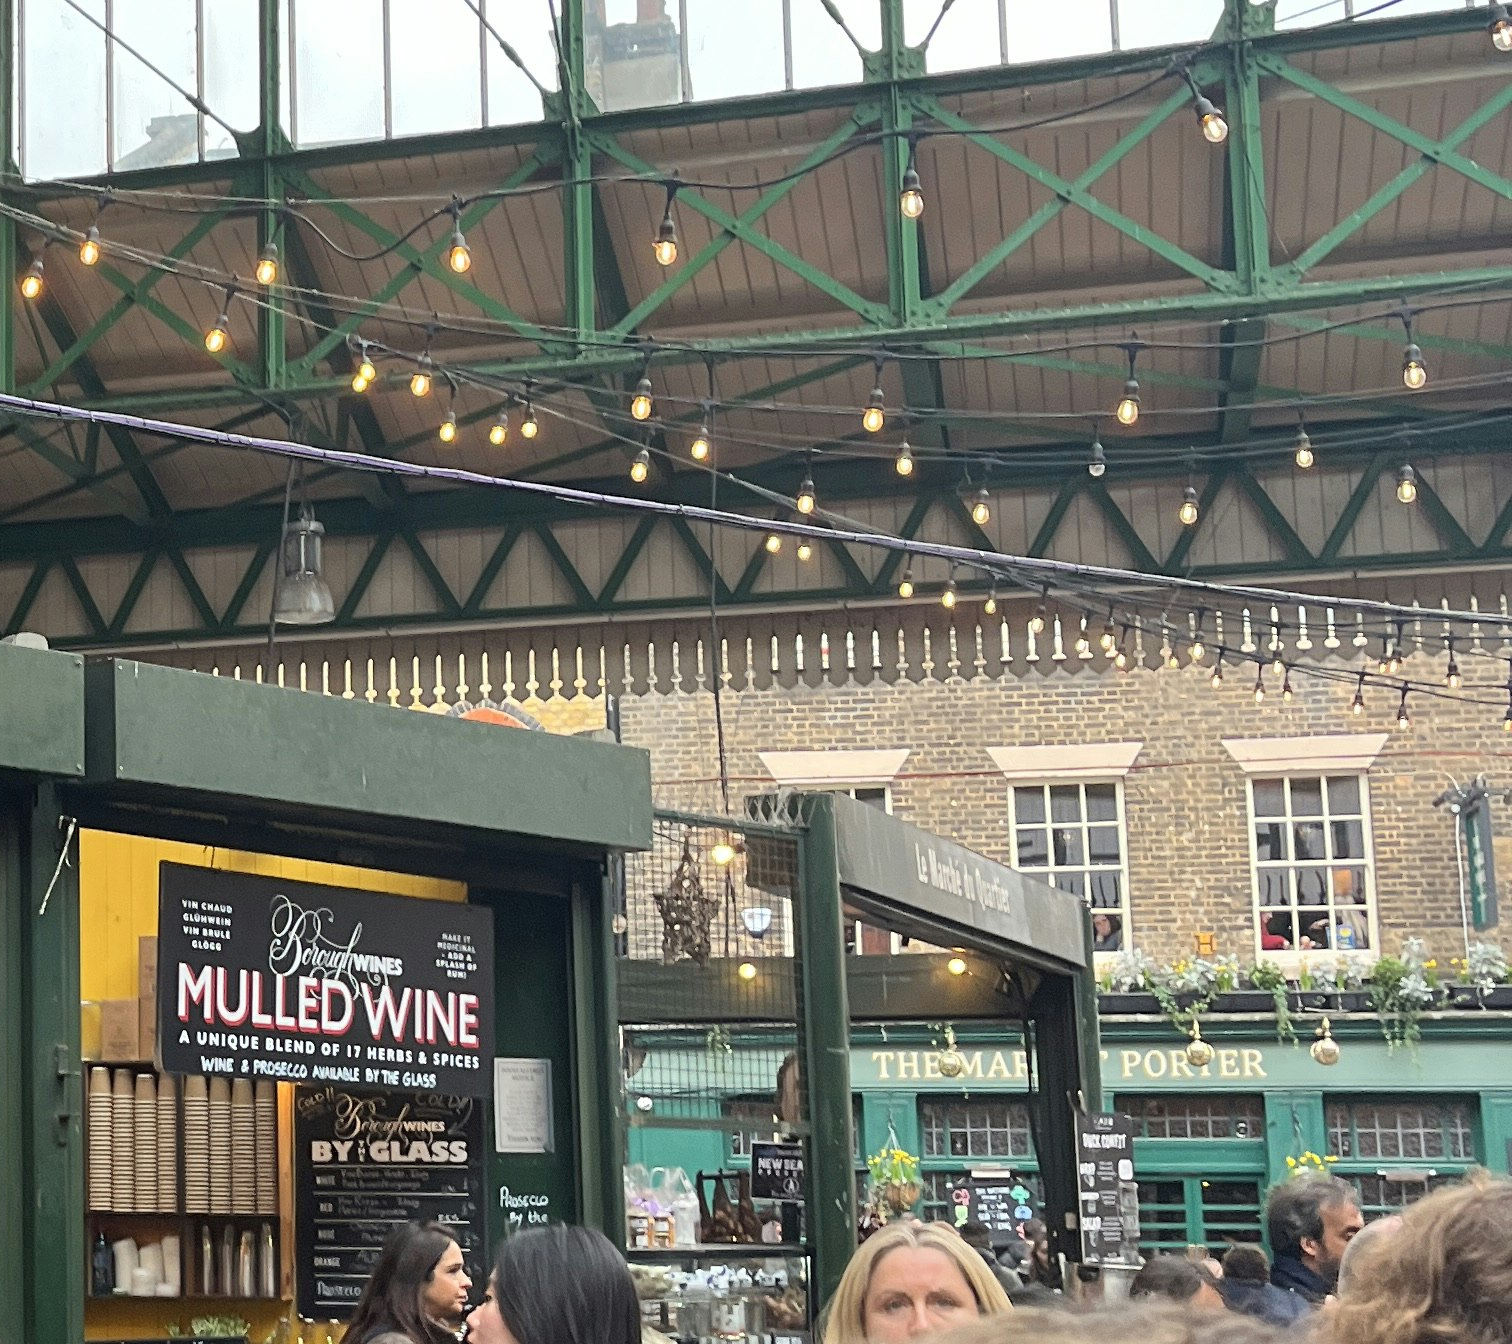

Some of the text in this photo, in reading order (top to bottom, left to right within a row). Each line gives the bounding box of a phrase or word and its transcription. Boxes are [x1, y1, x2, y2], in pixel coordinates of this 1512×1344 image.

[915, 842, 928, 884] Le
[182, 899, 233, 914] VIN CHAUD
[183, 925, 200, 936] VIN
[352, 953, 403, 977] WINES
[435, 958, 466, 970] SPLASH
[447, 952, 464, 961] ADD
[466, 953, 472, 962] A
[177, 961, 480, 1049] MULLED WINE
[179, 1029, 480, 1070] A UNIQUE BLEND OF 17 HERBS & SPICES
[200, 1055, 437, 1089] WINE & PROSECCO AVAILABLE BY THE GLASS
[873, 1051, 944, 1080] THE
[402, 1120, 446, 1133] WINES
[311, 1140, 354, 1163] BY
[369, 1140, 468, 1163] GLASS
